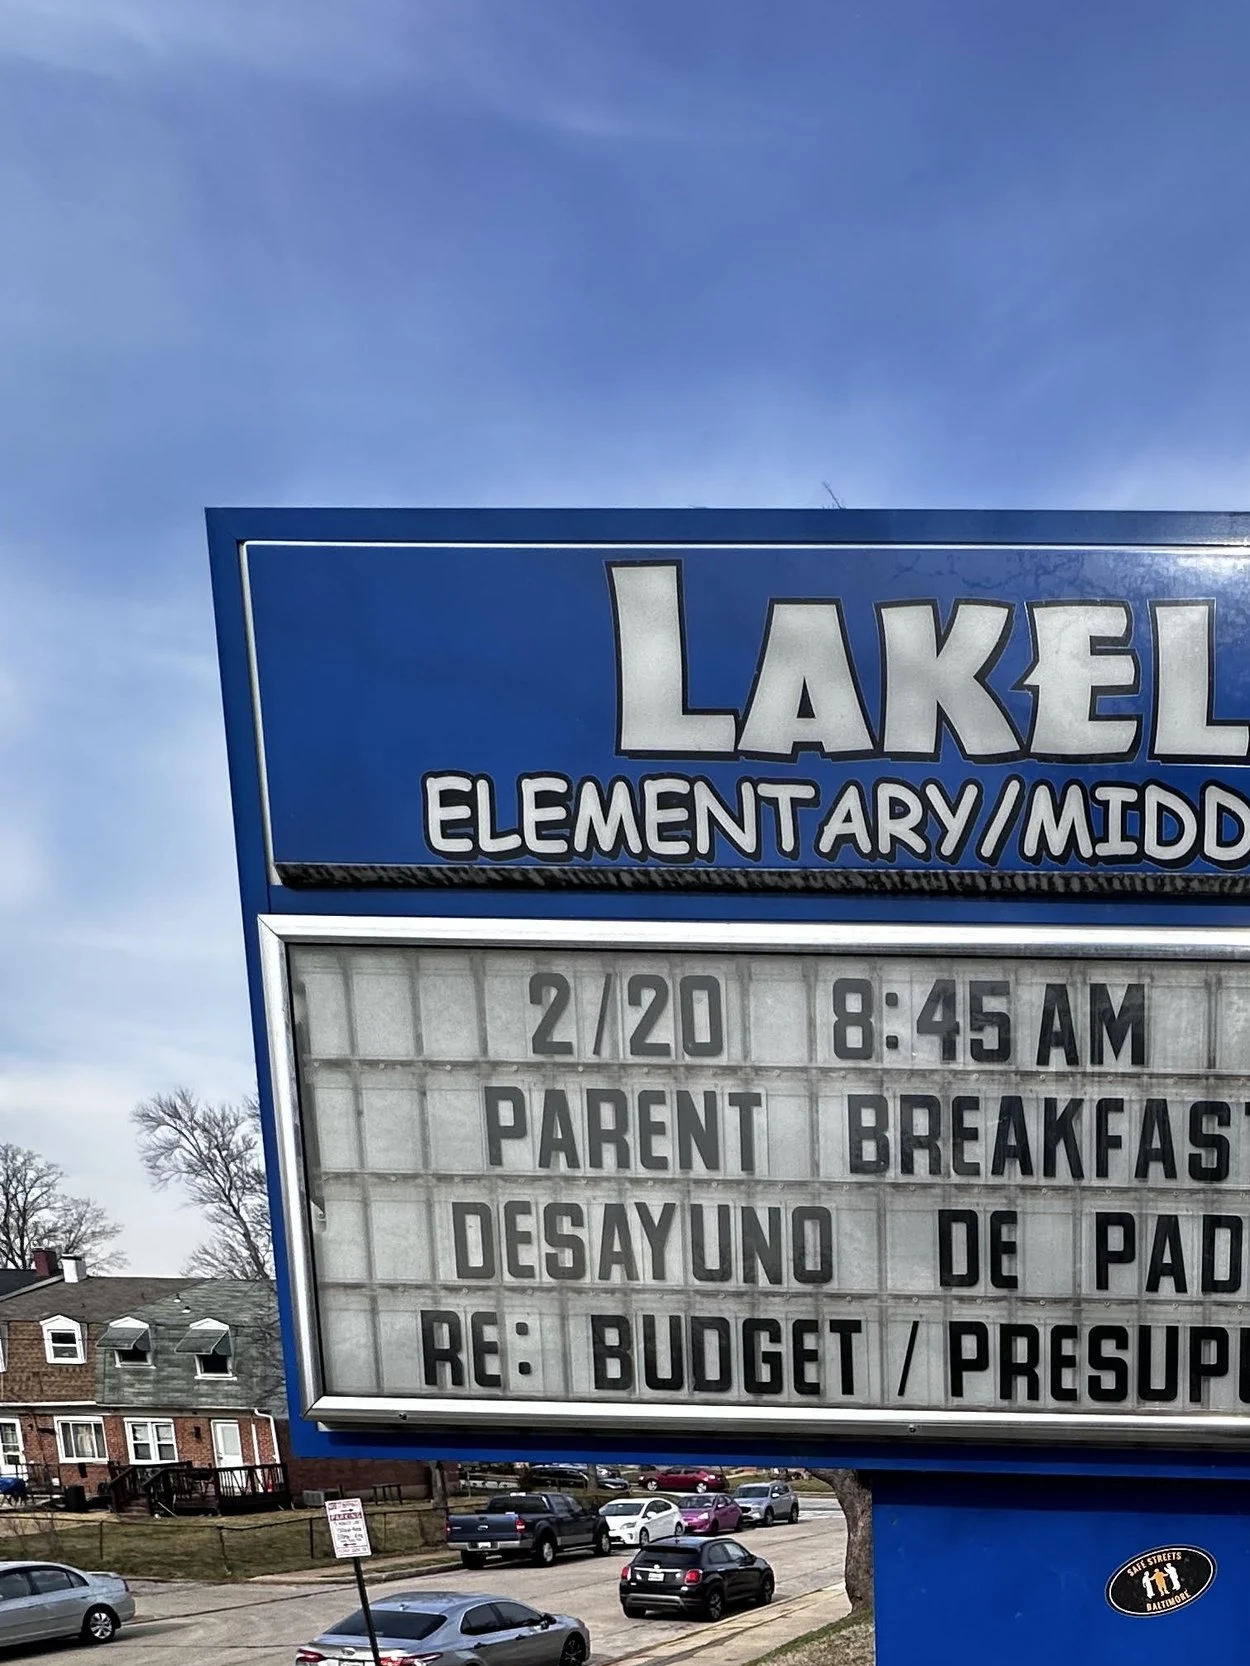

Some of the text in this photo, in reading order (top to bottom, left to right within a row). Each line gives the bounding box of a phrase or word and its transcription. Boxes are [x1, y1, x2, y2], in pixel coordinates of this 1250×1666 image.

[529, 971, 1147, 1067] 2/20 8:45 AM
[484, 1086, 761, 1172] PARENT
[452, 1200, 833, 1285] DESAYUNO
[938, 1208, 1018, 1289] DE
[420, 1310, 532, 1388] RE:
[591, 1314, 862, 1396] BUDGET
[1127, 1552, 1182, 1577] SAFE STREETS
[1146, 1589, 1191, 1611] BALTIMORE
